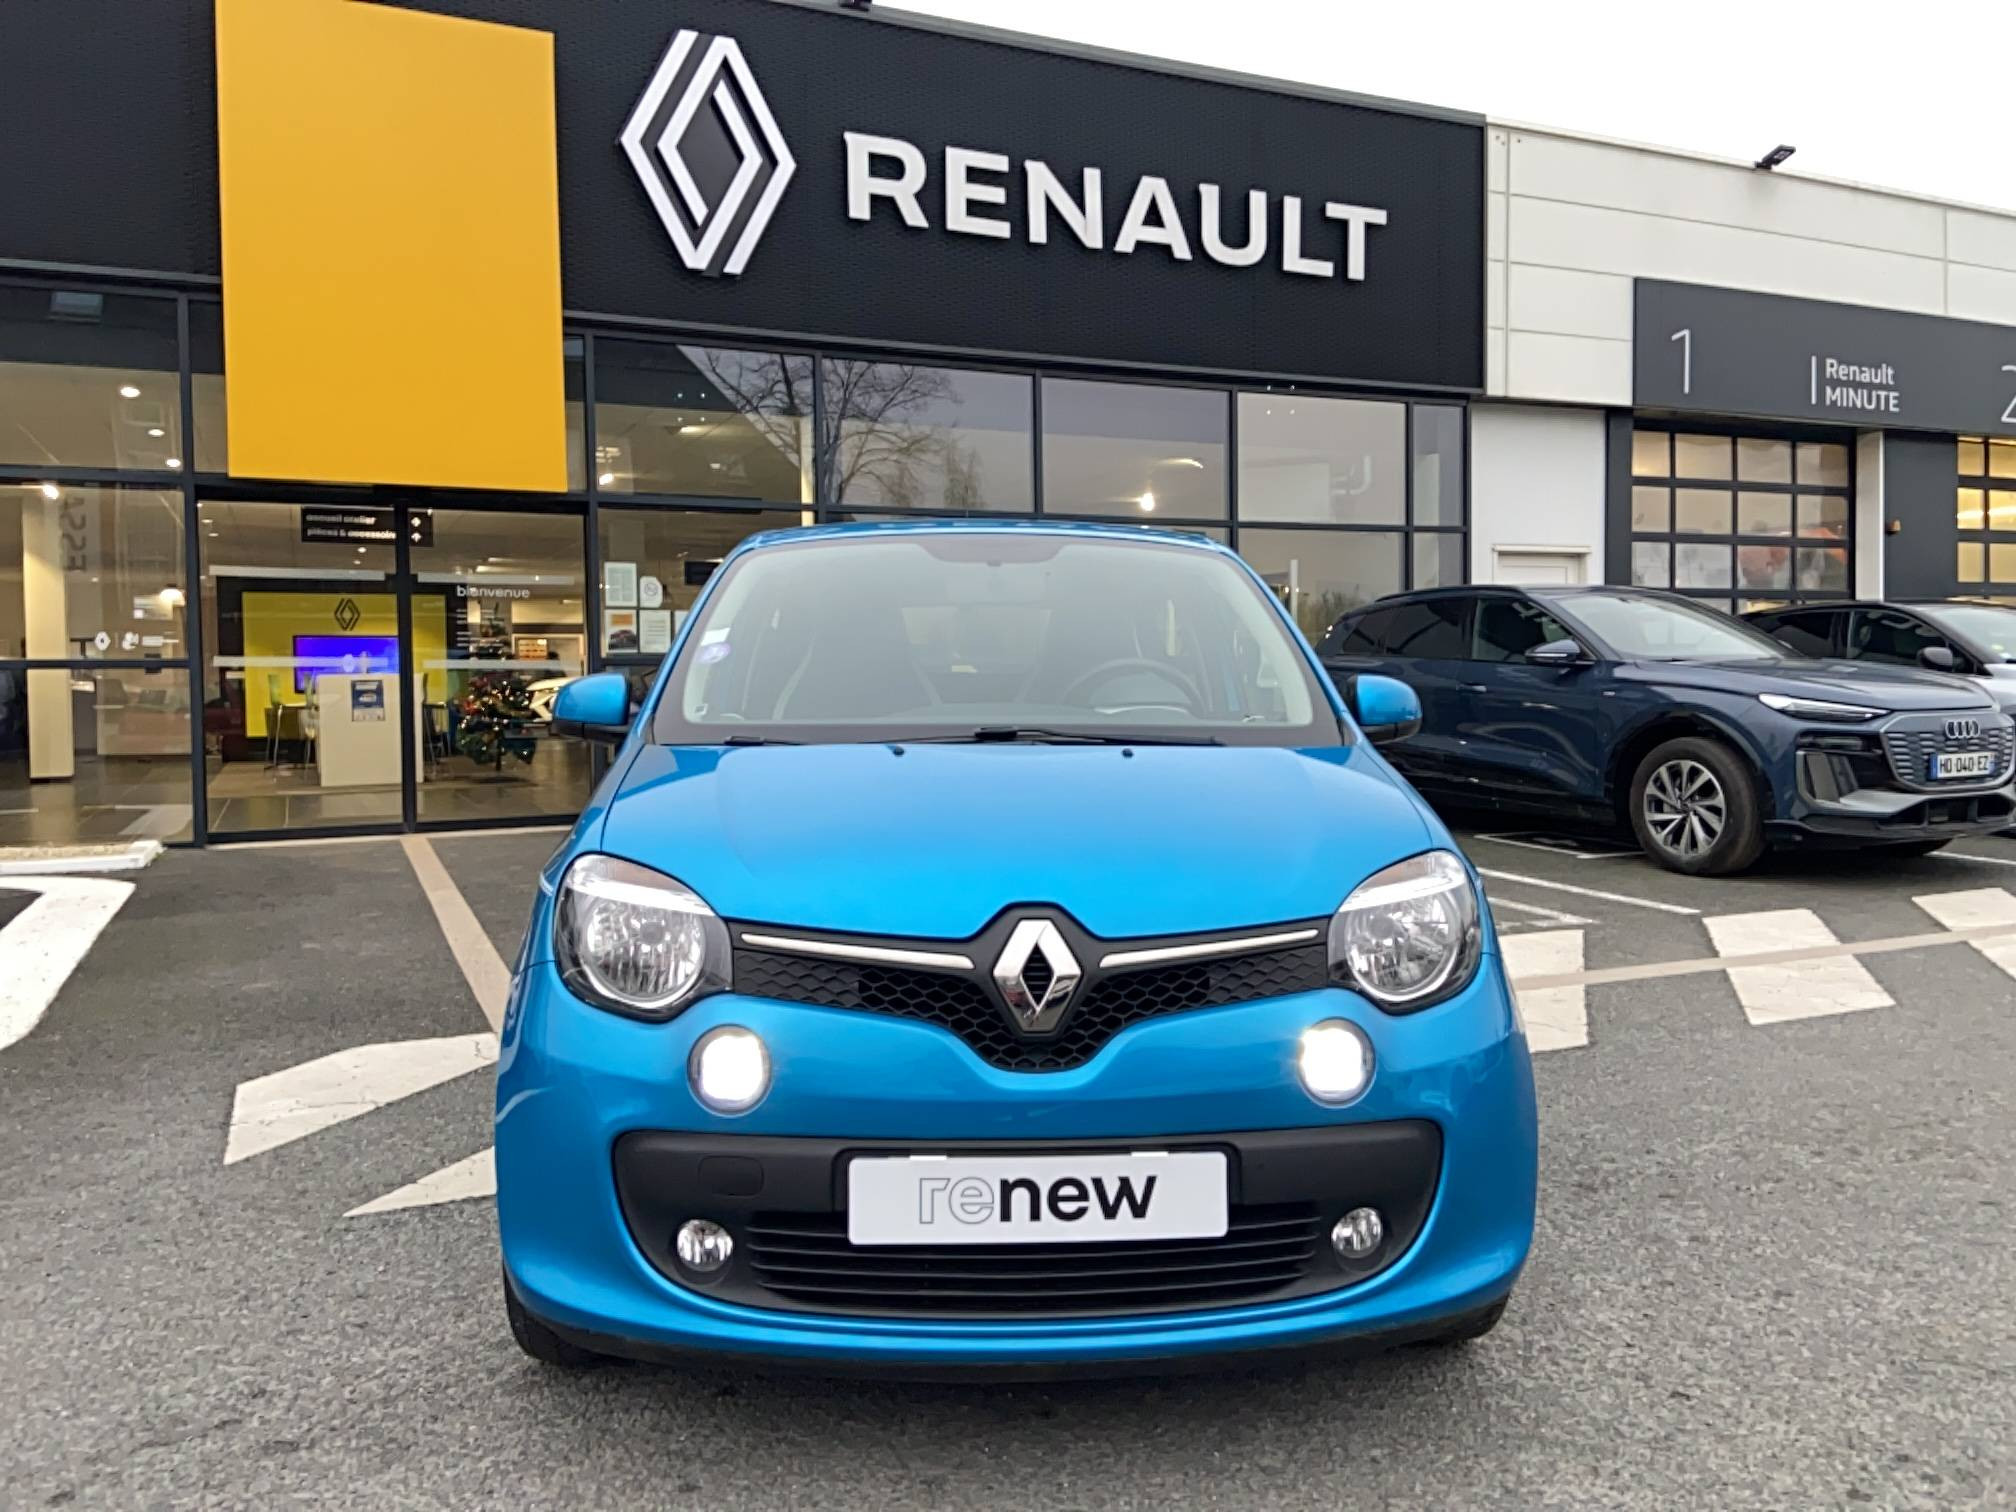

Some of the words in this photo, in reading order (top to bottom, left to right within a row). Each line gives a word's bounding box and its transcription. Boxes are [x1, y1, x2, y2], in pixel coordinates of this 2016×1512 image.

[843, 131, 1388, 281] RENAULT
[1671, 328, 1690, 395] 1
[1825, 357, 1895, 386] Renault
[1825, 385, 1900, 413] MINUTE
[456, 585, 531, 598] bienvenue
[918, 1175, 1158, 1225] renew
